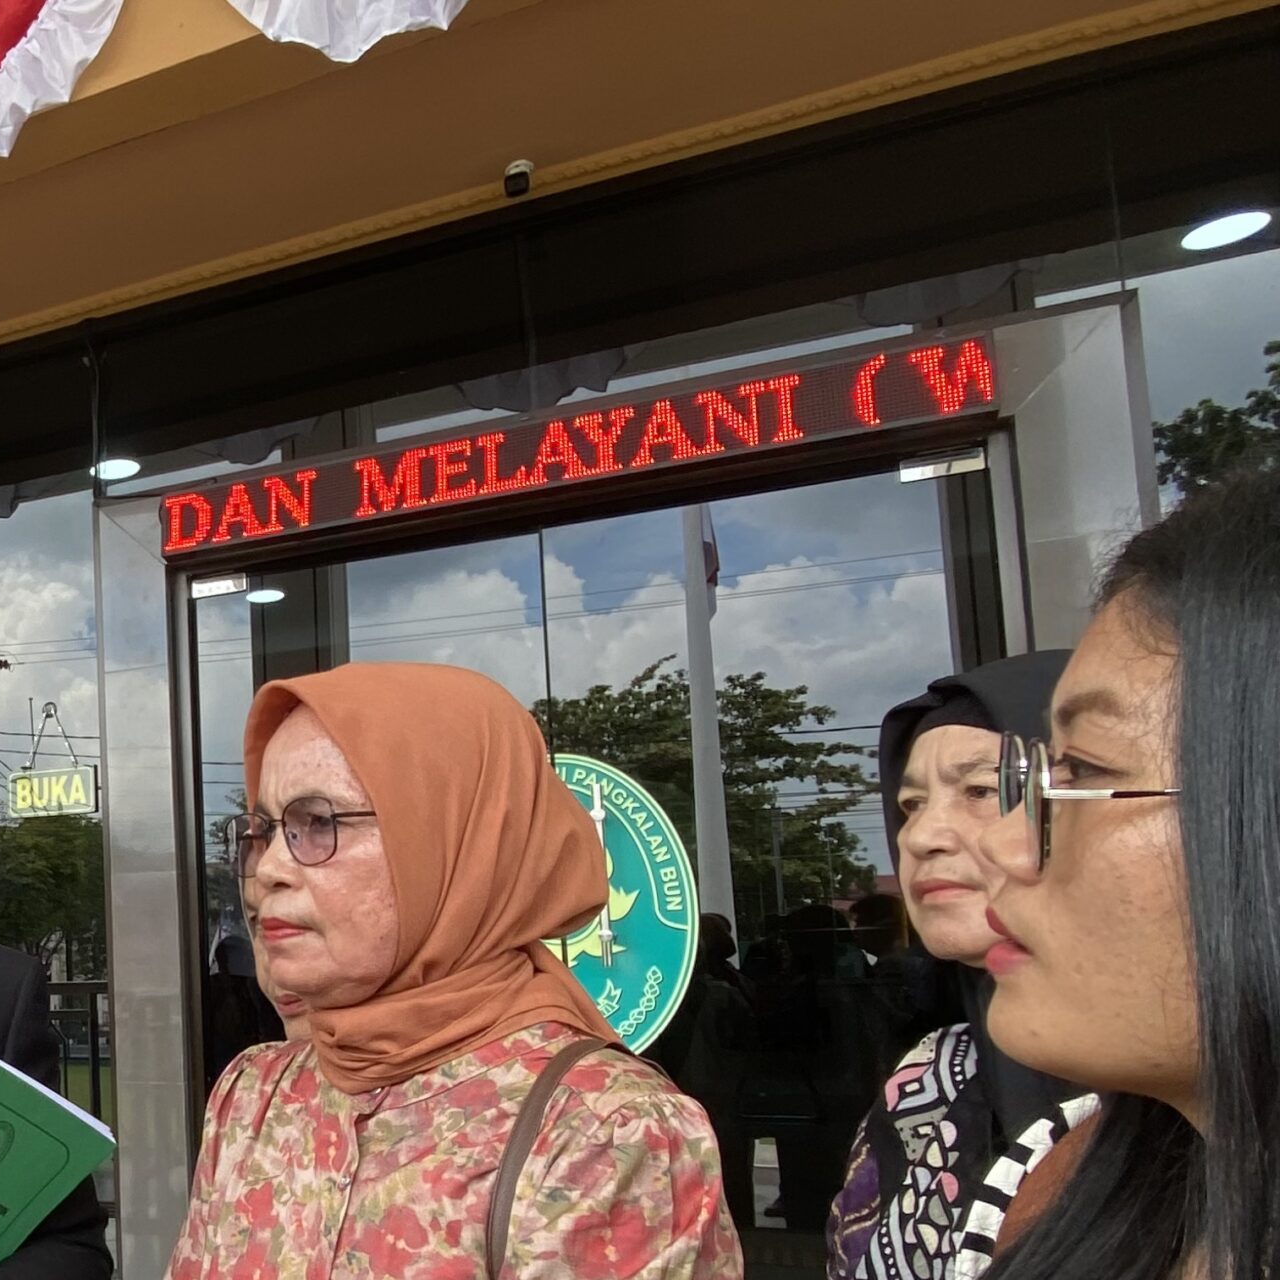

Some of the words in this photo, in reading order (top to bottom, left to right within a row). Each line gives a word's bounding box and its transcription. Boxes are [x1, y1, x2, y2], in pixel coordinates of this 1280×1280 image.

[164, 470, 317, 552] DAN
[354, 373, 803, 517] MELAYANI
[15, 773, 86, 810] BUKA
[572, 770, 671, 863] PANGKALAN
[659, 867, 683, 911] BUN
